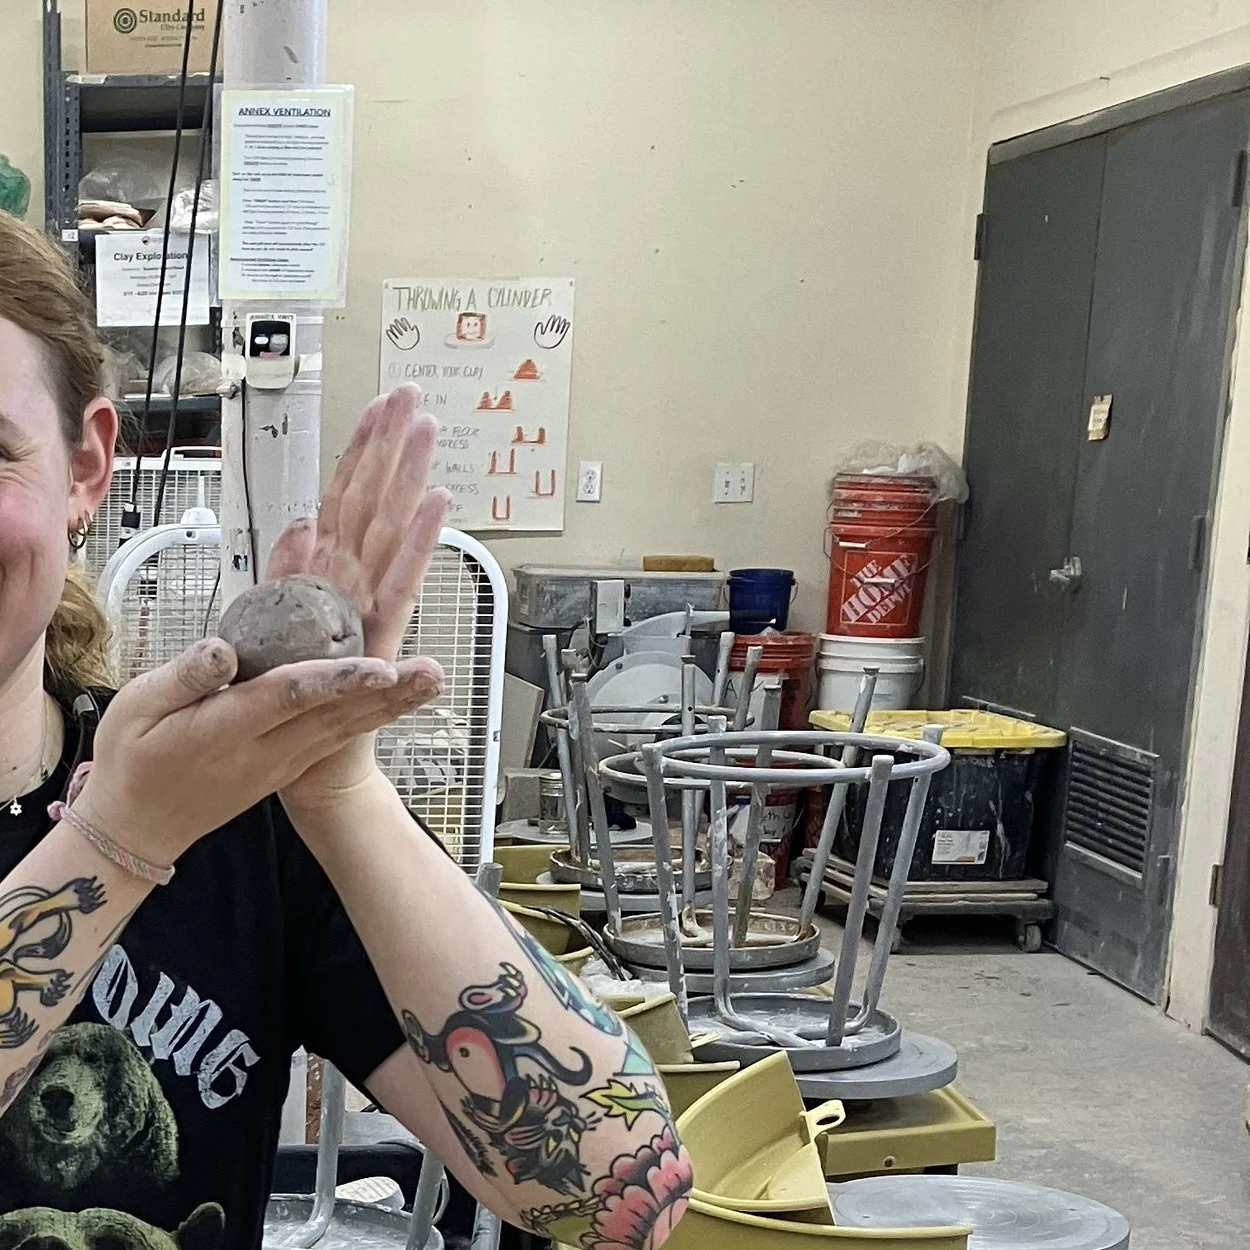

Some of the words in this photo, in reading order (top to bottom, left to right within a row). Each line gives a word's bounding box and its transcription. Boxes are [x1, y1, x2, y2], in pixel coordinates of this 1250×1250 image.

[139, 8, 205, 23] Standard
[238, 107, 271, 117] ANNEX
[273, 107, 332, 118] VENTILATION
[113, 252, 134, 263] Clay
[392, 286, 461, 312] THROWING
[466, 288, 477, 311] A
[488, 287, 553, 309] CYLINDER
[405, 363, 439, 379] CENTER
[436, 393, 448, 406] IN
[842, 554, 917, 622] HOME
